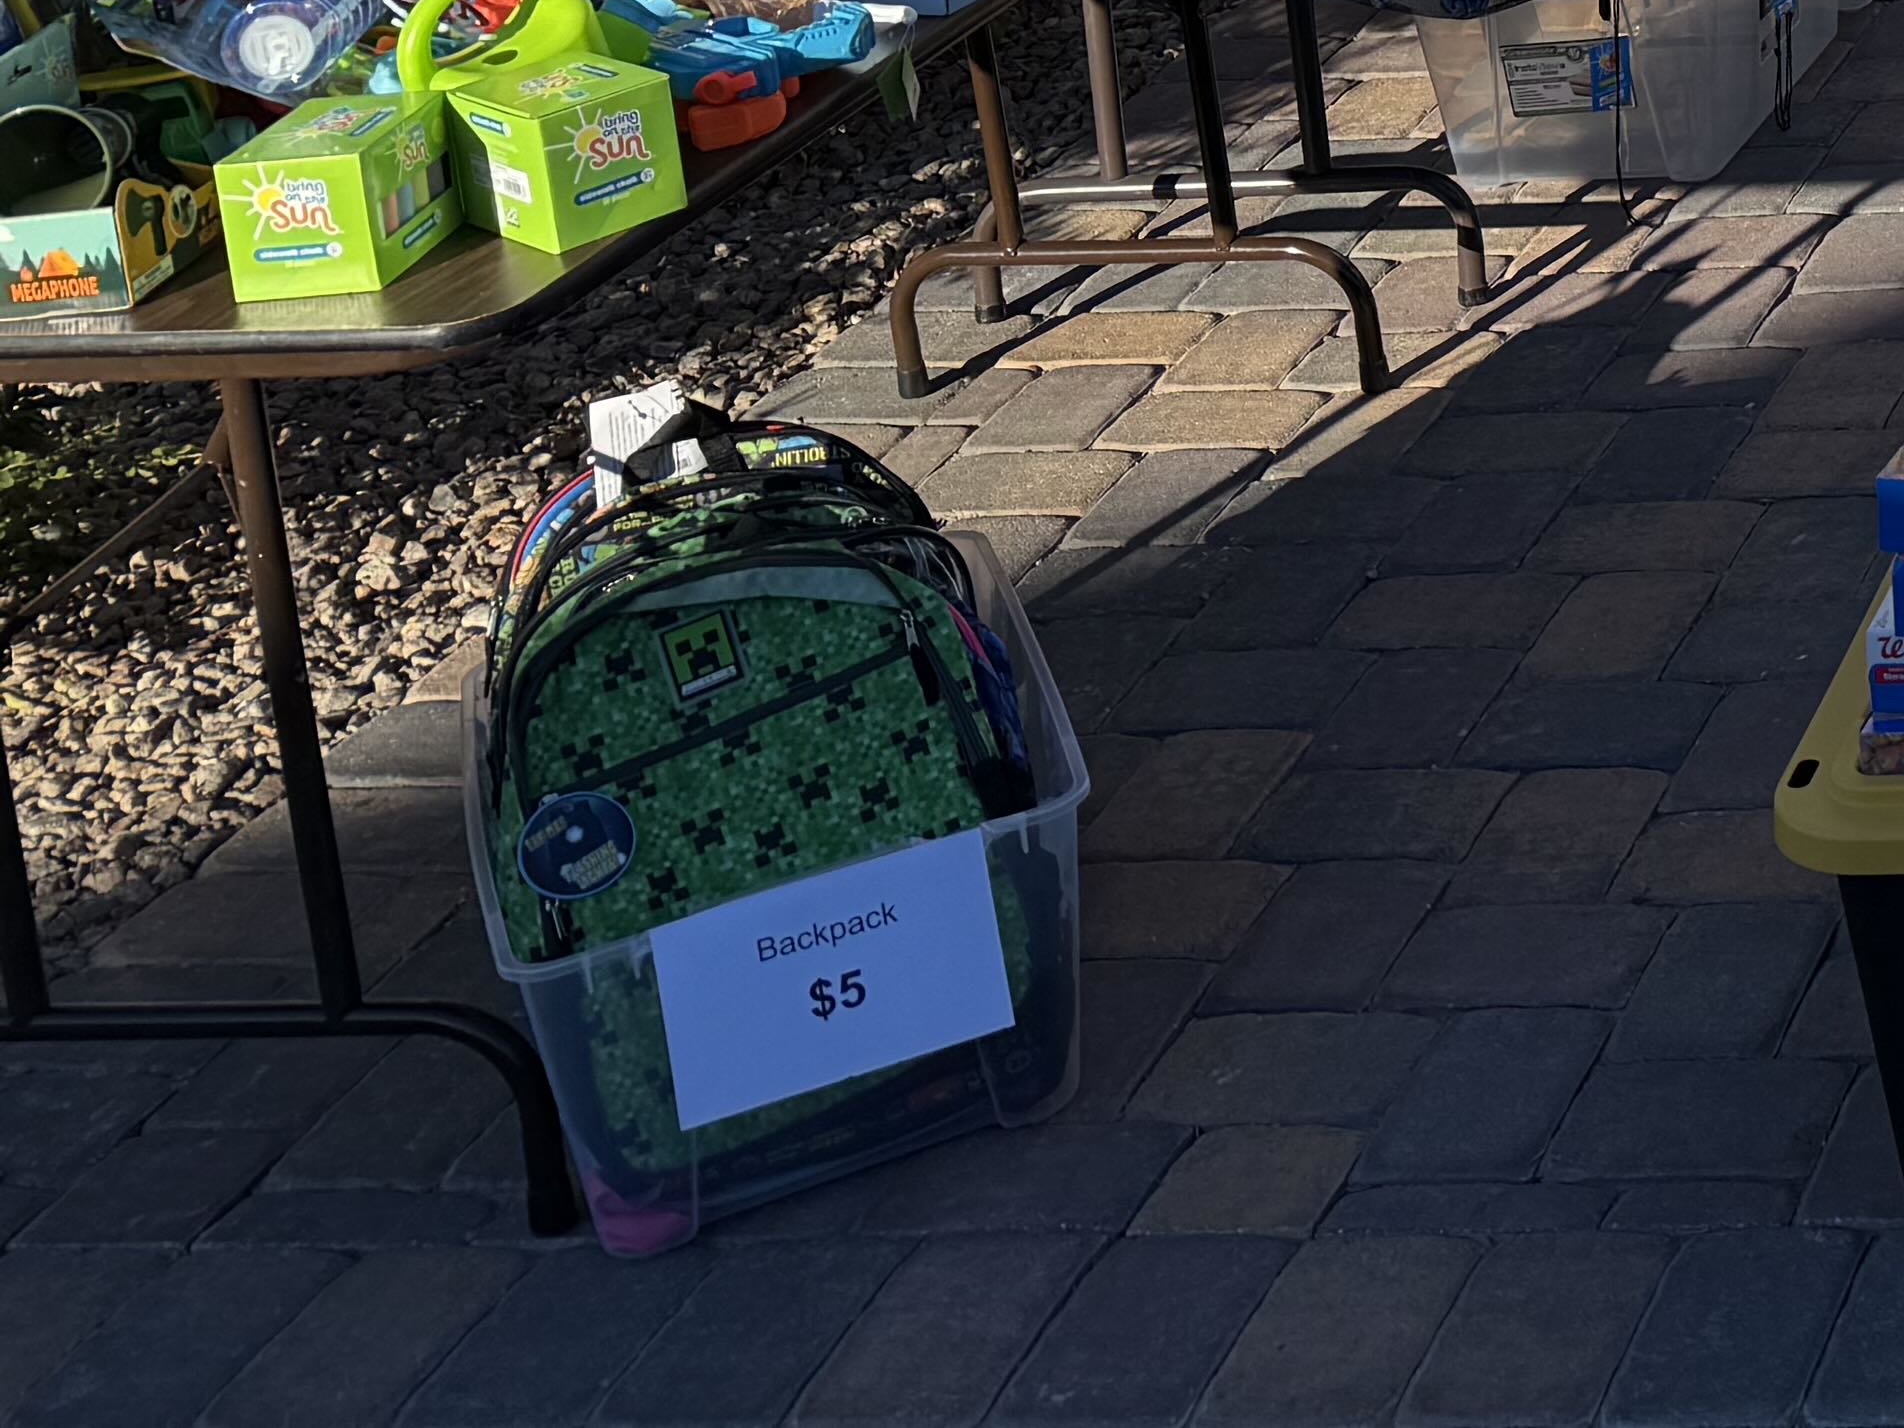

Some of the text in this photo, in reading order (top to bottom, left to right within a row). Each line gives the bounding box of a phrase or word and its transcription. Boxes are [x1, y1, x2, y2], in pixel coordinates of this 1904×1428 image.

[602, 127, 622, 137] on
[603, 110, 641, 129] bring
[589, 133, 652, 170] Sun
[285, 193, 302, 204] on
[286, 177, 326, 196] bring
[269, 200, 340, 235] Sun
[10, 275, 99, 303] MEGAPHONE
[756, 902, 899, 963] Backpack
[809, 969, 867, 1024] $5
